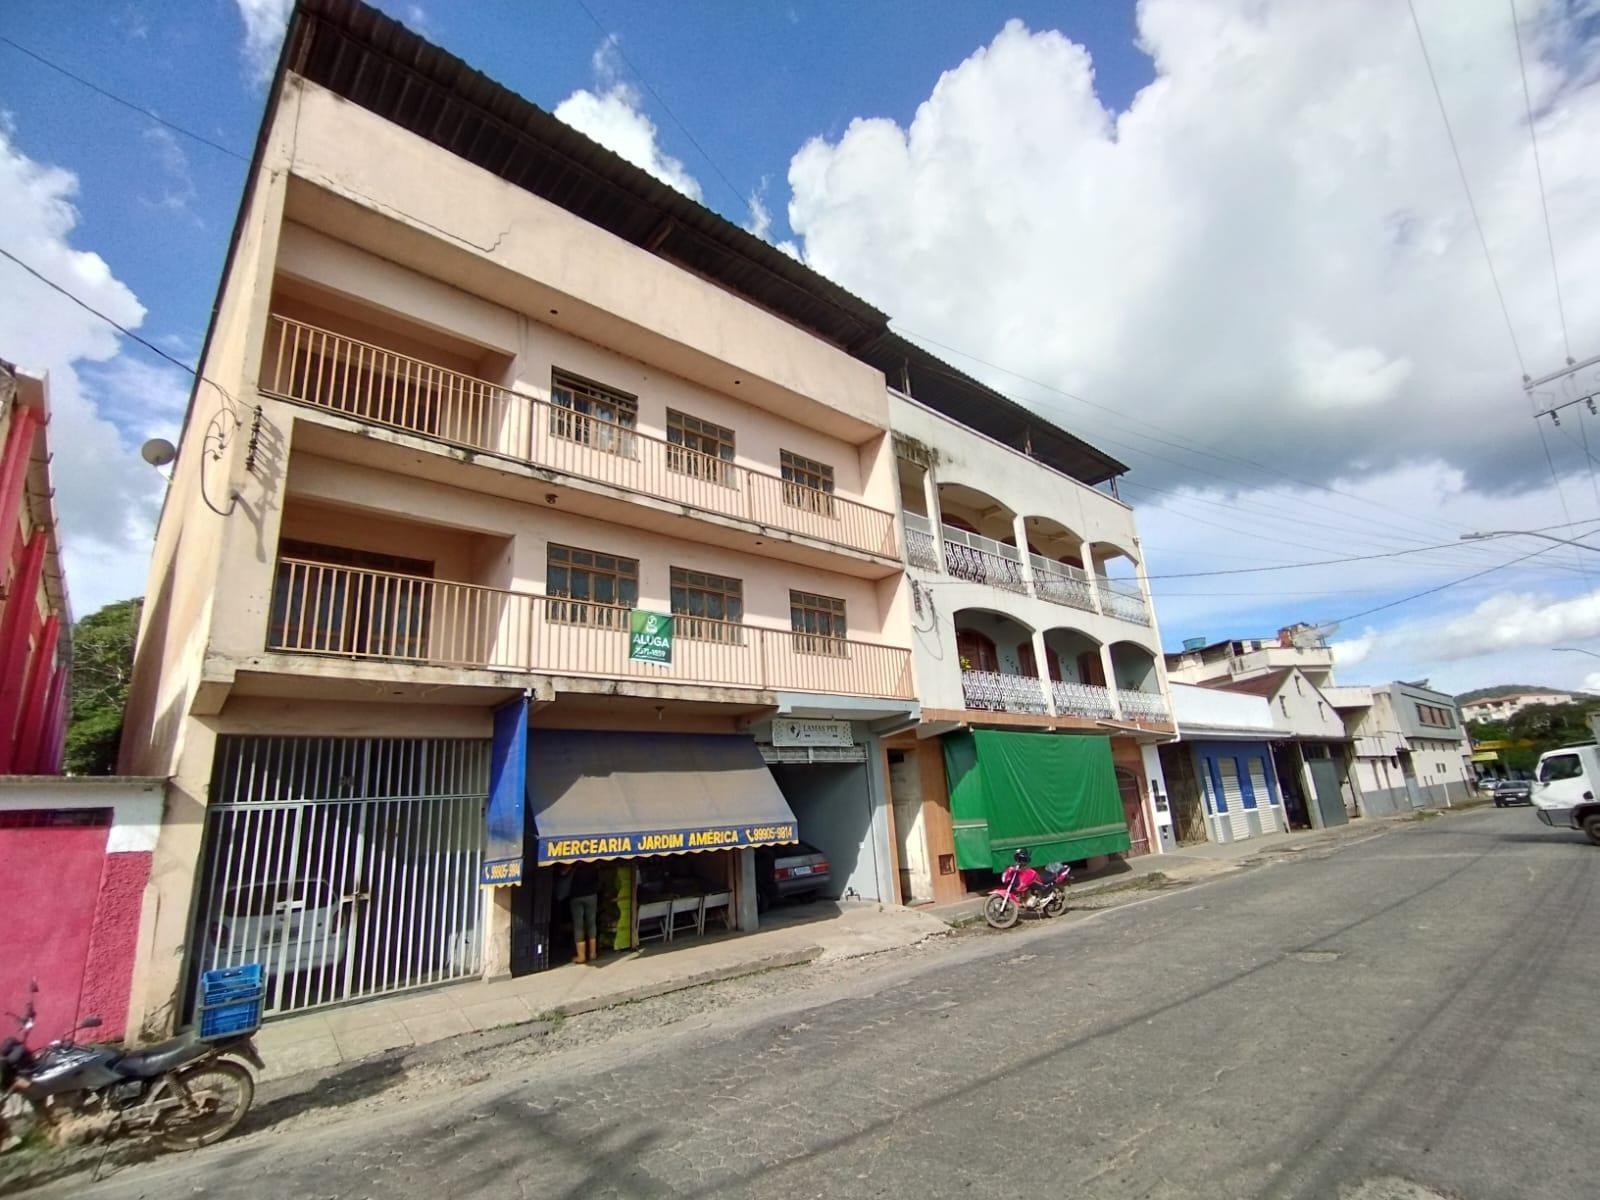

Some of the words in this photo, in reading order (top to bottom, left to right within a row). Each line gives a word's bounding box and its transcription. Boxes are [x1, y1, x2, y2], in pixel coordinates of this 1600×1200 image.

[632, 633, 670, 648] ALUGA
[547, 837, 632, 857] MERCEARIA
[637, 833, 684, 850] JARDIM
[688, 829, 738, 847] AMÉRICA
